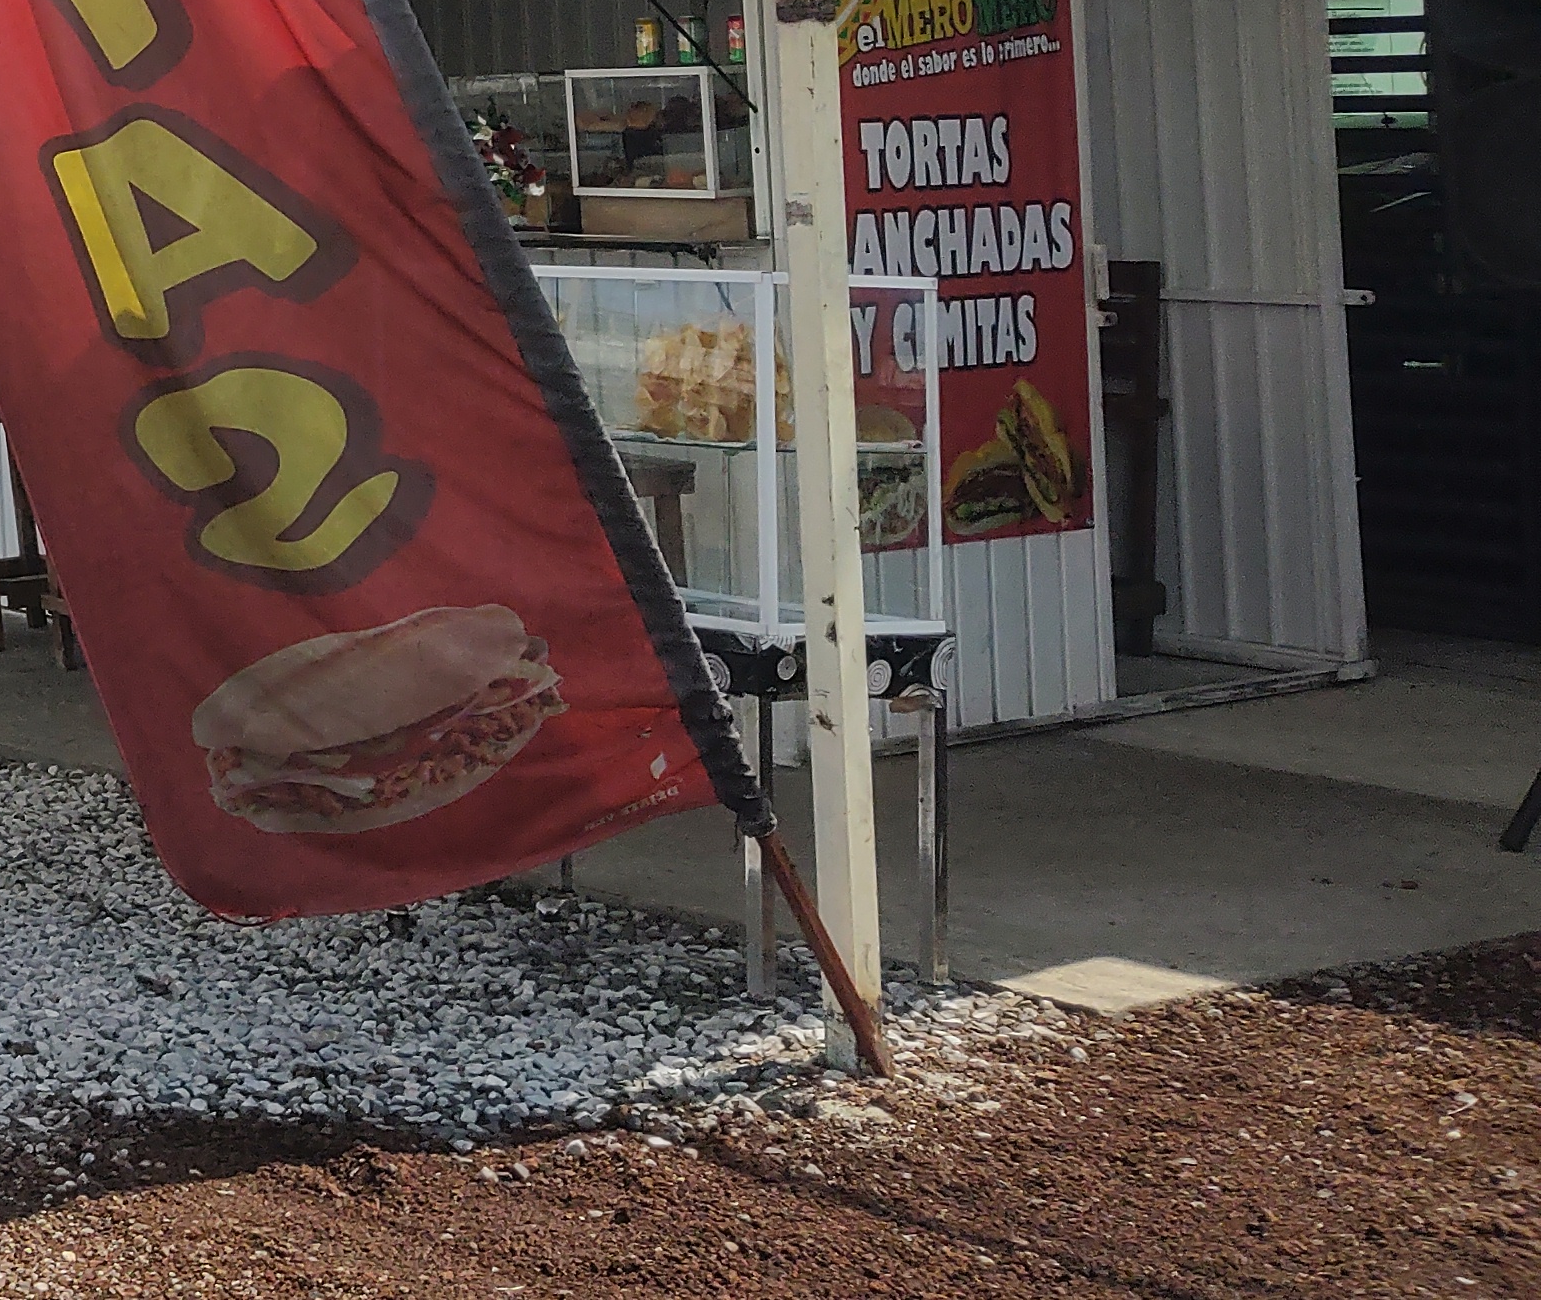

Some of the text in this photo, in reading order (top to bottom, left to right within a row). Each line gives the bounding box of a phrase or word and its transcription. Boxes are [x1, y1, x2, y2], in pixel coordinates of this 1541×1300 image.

[852, 59, 896, 87] donde
[901, 55, 914, 78] el
[918, 50, 957, 76] sabor
[962, 49, 977, 68] es
[982, 42, 994, 65] lo
[860, 116, 1010, 189] TORTAS
[848, 202, 1073, 277] ANCHADAS
[852, 306, 876, 374] Y
